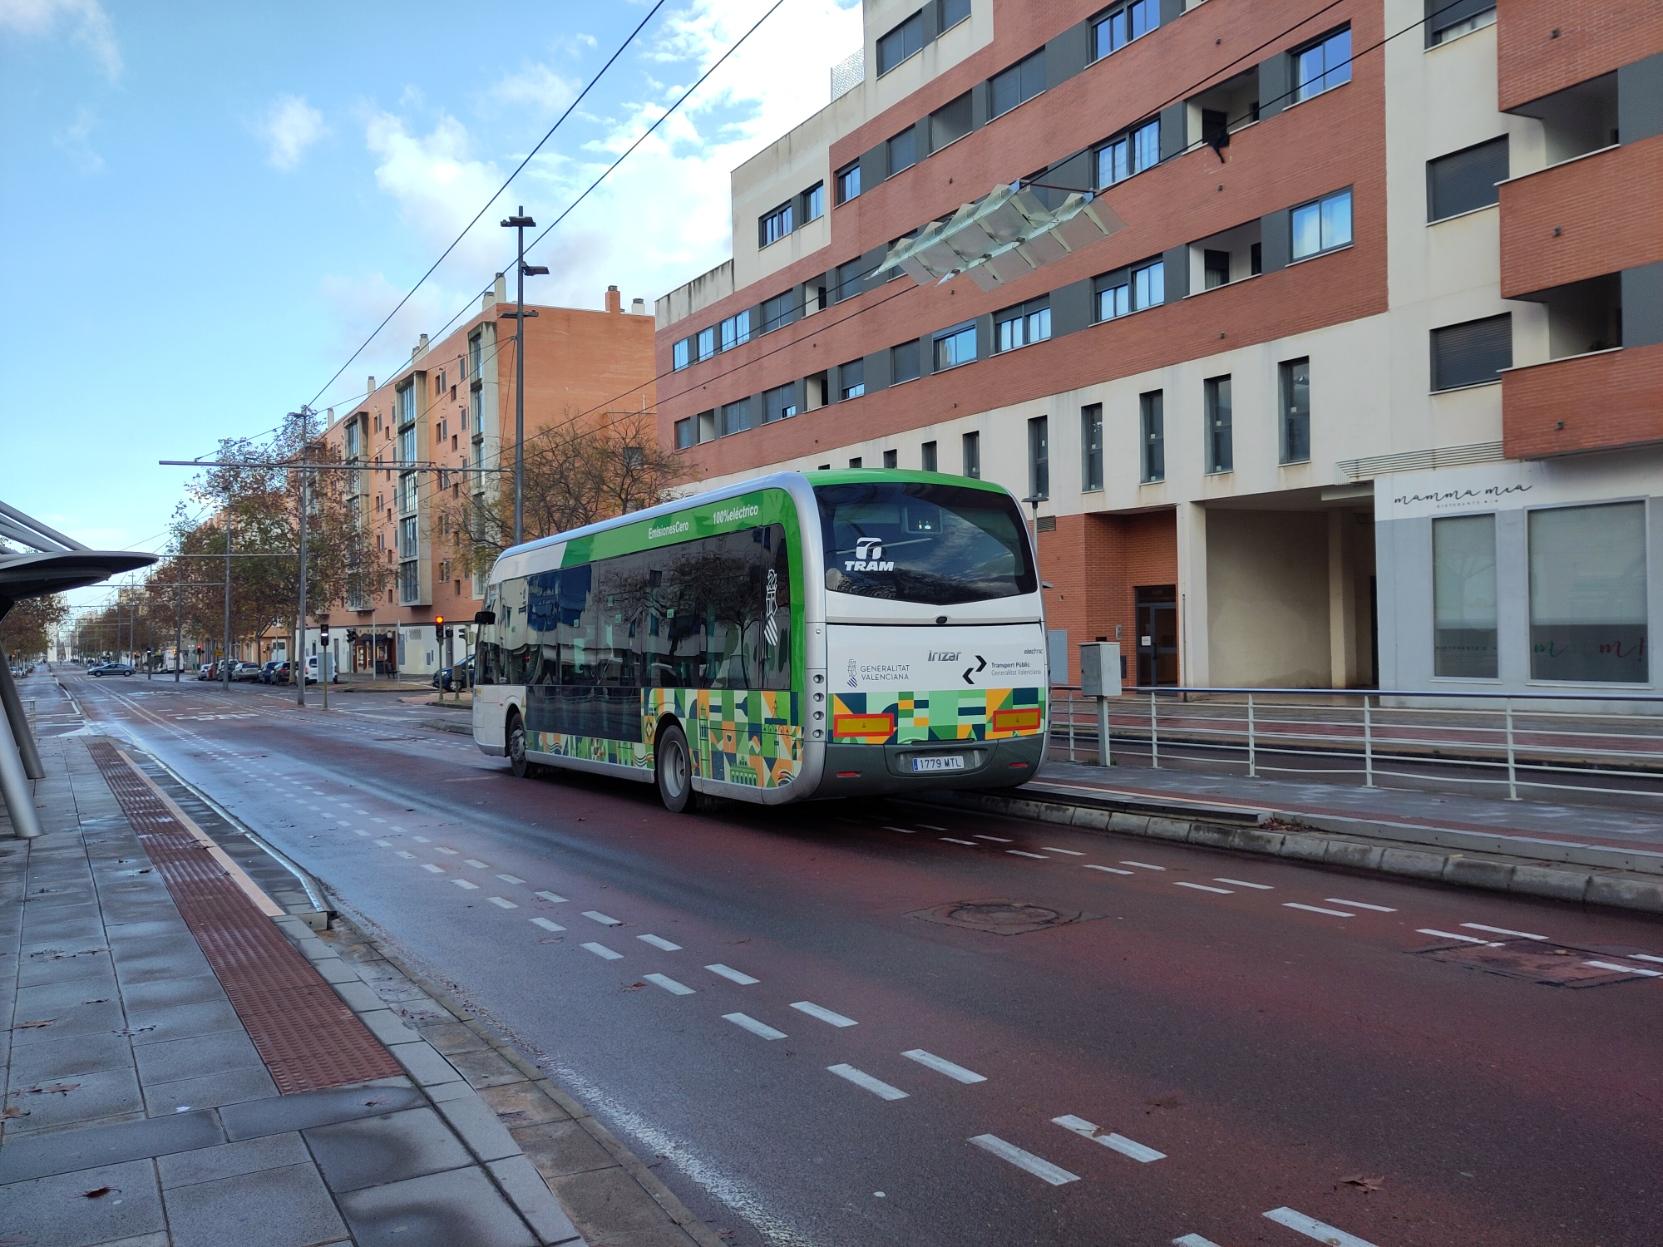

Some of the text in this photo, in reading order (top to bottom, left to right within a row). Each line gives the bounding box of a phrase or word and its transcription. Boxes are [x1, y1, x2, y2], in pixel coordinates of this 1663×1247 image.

[1394, 489, 1481, 505] mamma
[1485, 484, 1533, 496] mia
[844, 561, 895, 572] TRAM
[860, 664, 910, 673] GENERALITAT
[861, 673, 909, 681] VALENCIANA
[920, 758, 942, 769] 1779
